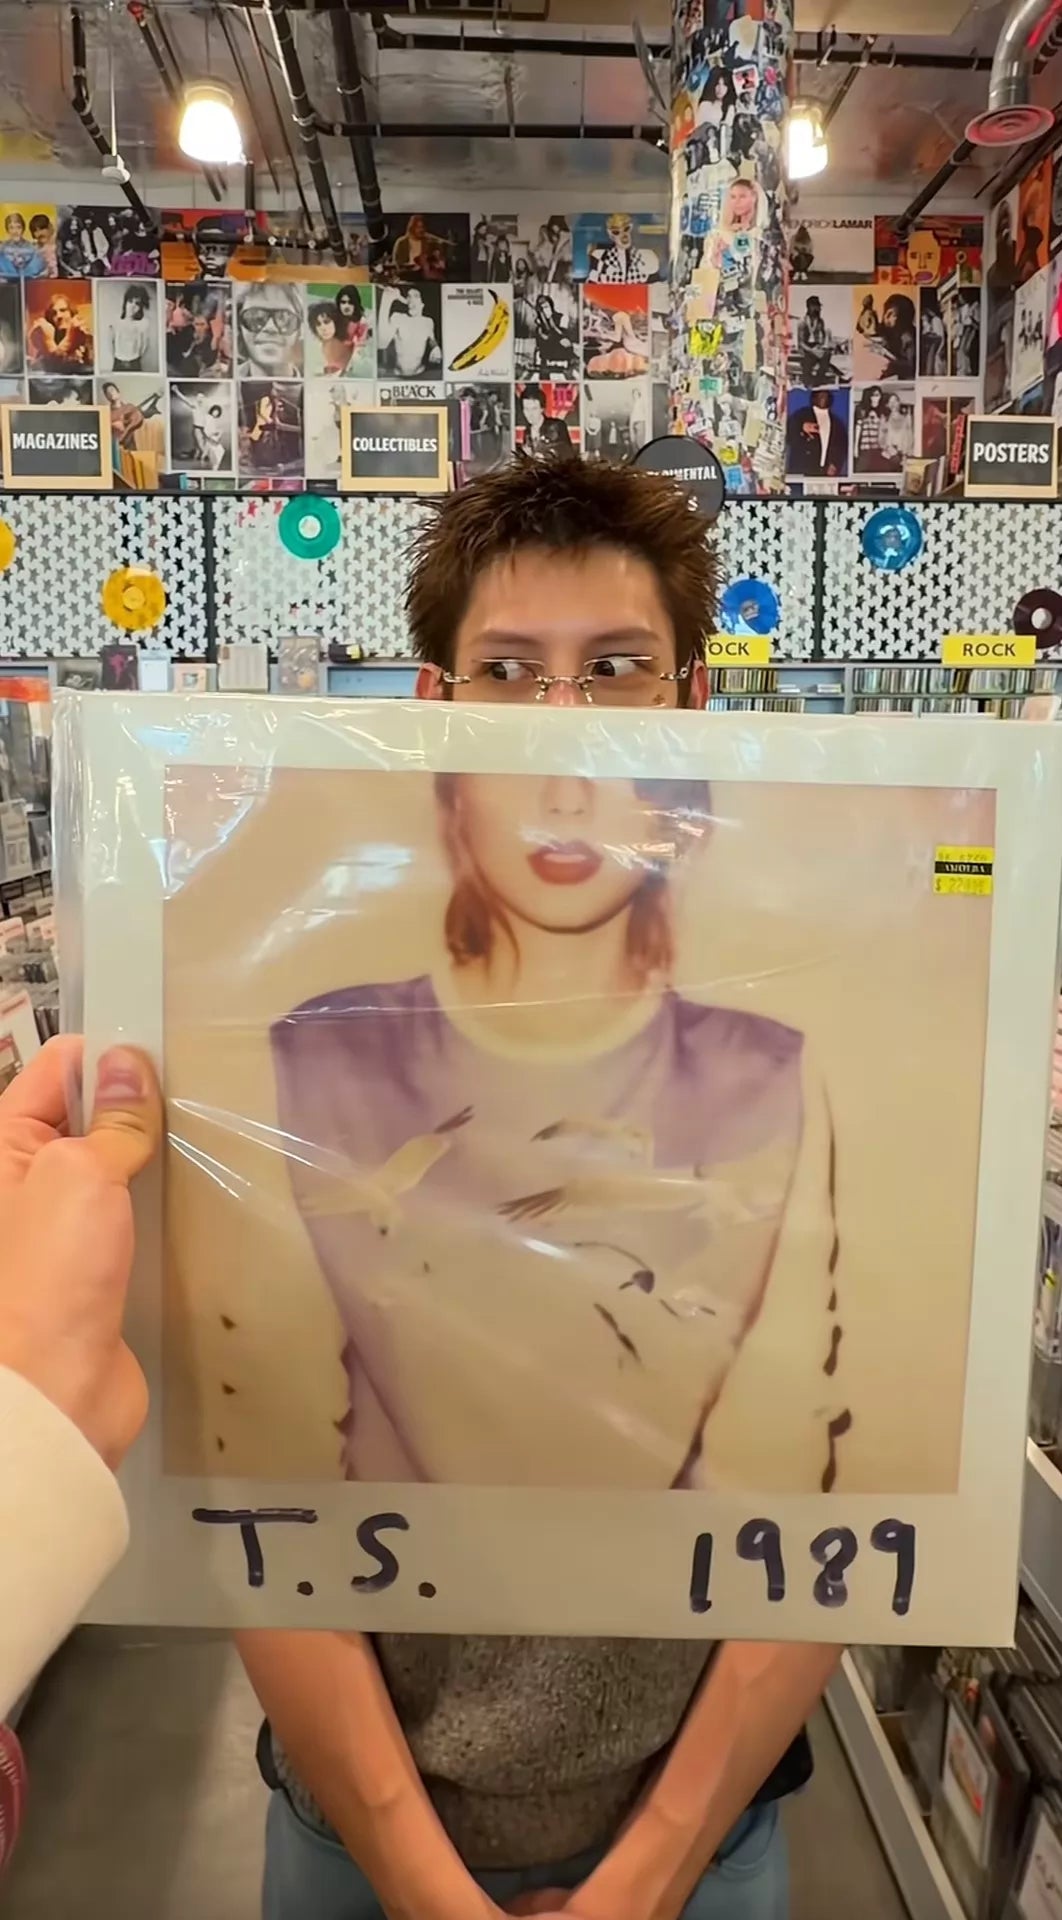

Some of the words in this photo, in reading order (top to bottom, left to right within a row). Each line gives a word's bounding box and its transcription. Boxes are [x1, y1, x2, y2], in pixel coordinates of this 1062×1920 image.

[832, 219, 873, 229] LAMAR
[392, 385, 437, 399] BLACK
[12, 432, 99, 450] MAGAZINES
[352, 436, 438, 453] COLLECTIBLES
[973, 441, 1050, 464] POSTERS
[708, 641, 750, 656] OCK
[962, 642, 1016, 657] ROCK
[689, 1517, 916, 1616] 1989
